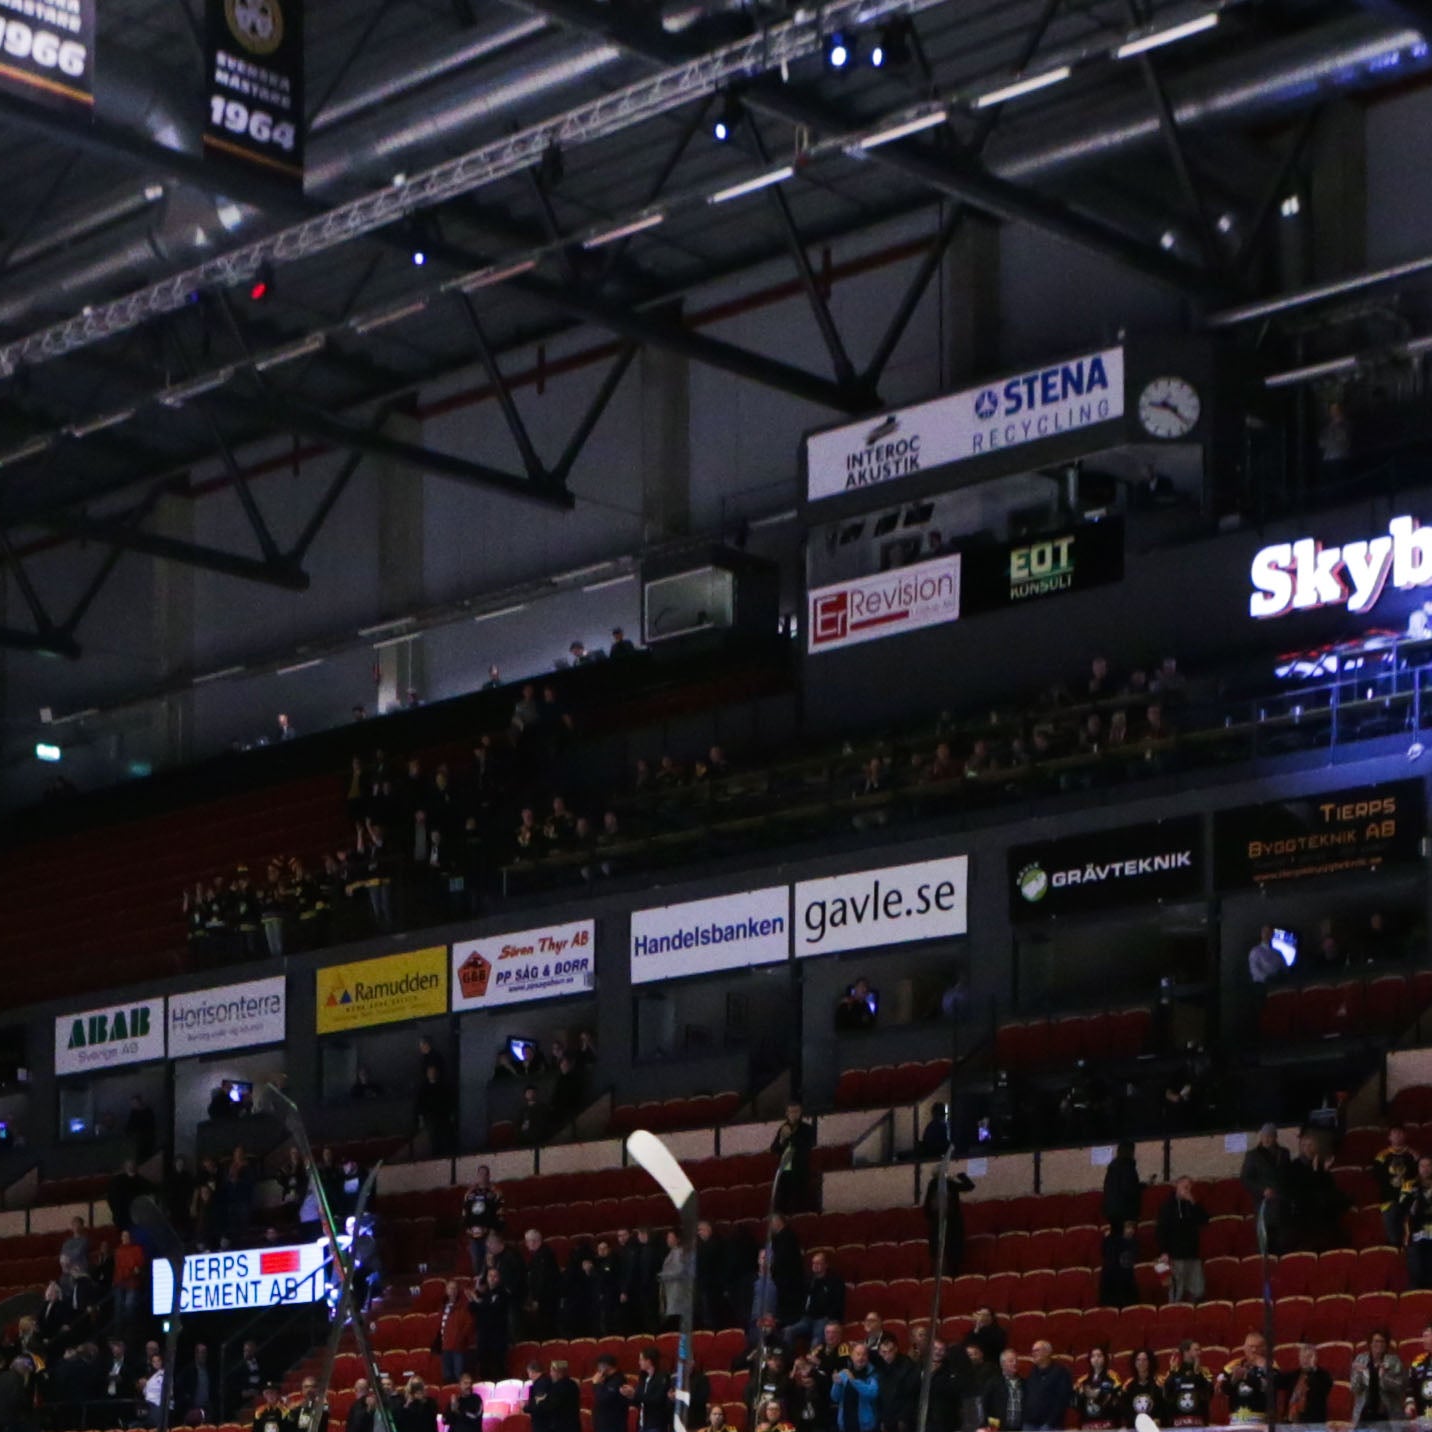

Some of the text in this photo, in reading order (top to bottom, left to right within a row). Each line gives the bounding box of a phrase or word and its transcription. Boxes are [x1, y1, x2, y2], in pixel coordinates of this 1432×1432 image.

[211, 95, 296, 149] 1964
[1004, 355, 1108, 416] STENA
[973, 398, 1110, 453] RECYCLING
[846, 435, 921, 470] INTEROC
[845, 455, 921, 489] AKUSTIK
[850, 571, 953, 617] Revision
[1366, 819, 1396, 840] AB
[1052, 851, 1192, 887] GRÄVTEKNIK
[805, 880, 956, 943] gavle.se
[539, 935, 569, 955] Thyr
[571, 930, 590, 949] AB
[634, 917, 785, 957] Handelsbanken
[355, 972, 440, 1002] Ramudden
[496, 971, 512, 985] PP
[515, 963, 539, 982] SÅG
[542, 964, 552, 977] &
[555, 958, 589, 975] BORR
[68, 1007, 151, 1049] ABAB
[172, 995, 281, 1030] Horisonterra
[179, 1277, 298, 1310] CEMENT AB
